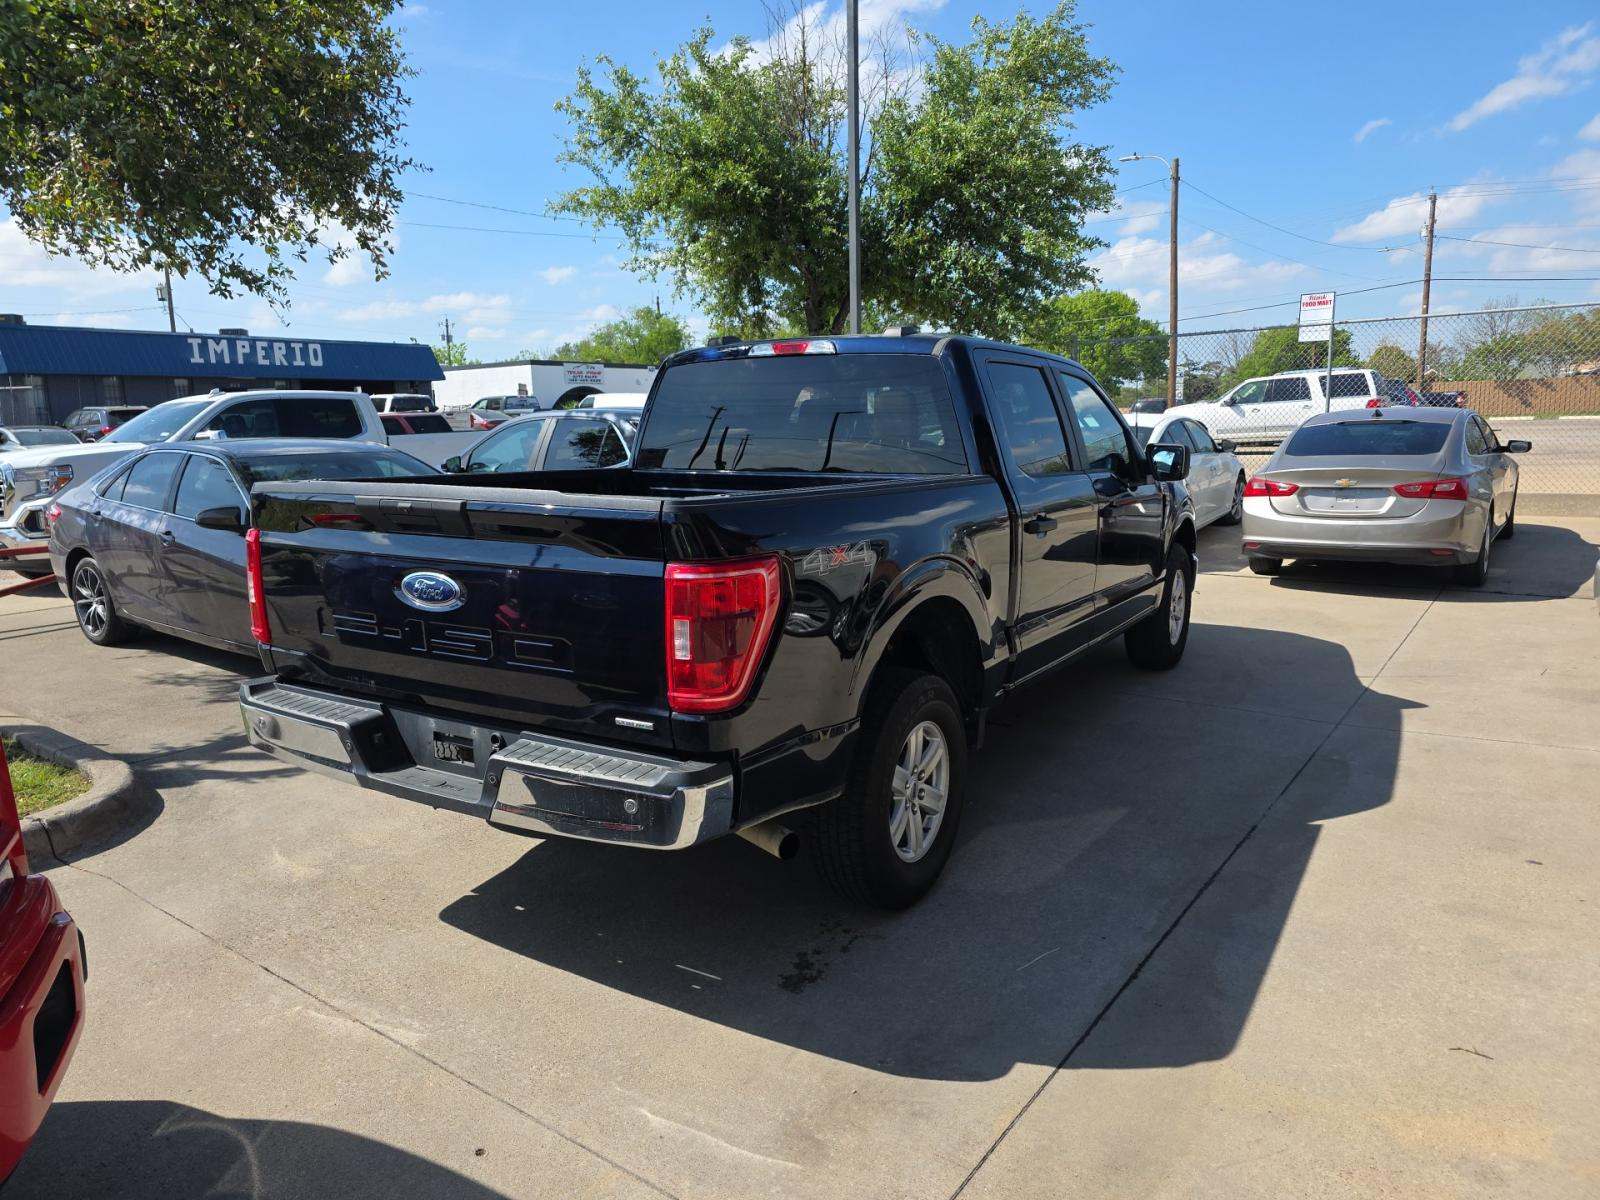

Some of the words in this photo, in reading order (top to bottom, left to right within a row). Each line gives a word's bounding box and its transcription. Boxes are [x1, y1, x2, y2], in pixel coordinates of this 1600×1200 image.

[187, 337, 324, 367] IMPERIO
[413, 578, 444, 600] Ford
[317, 606, 575, 673] F-150
